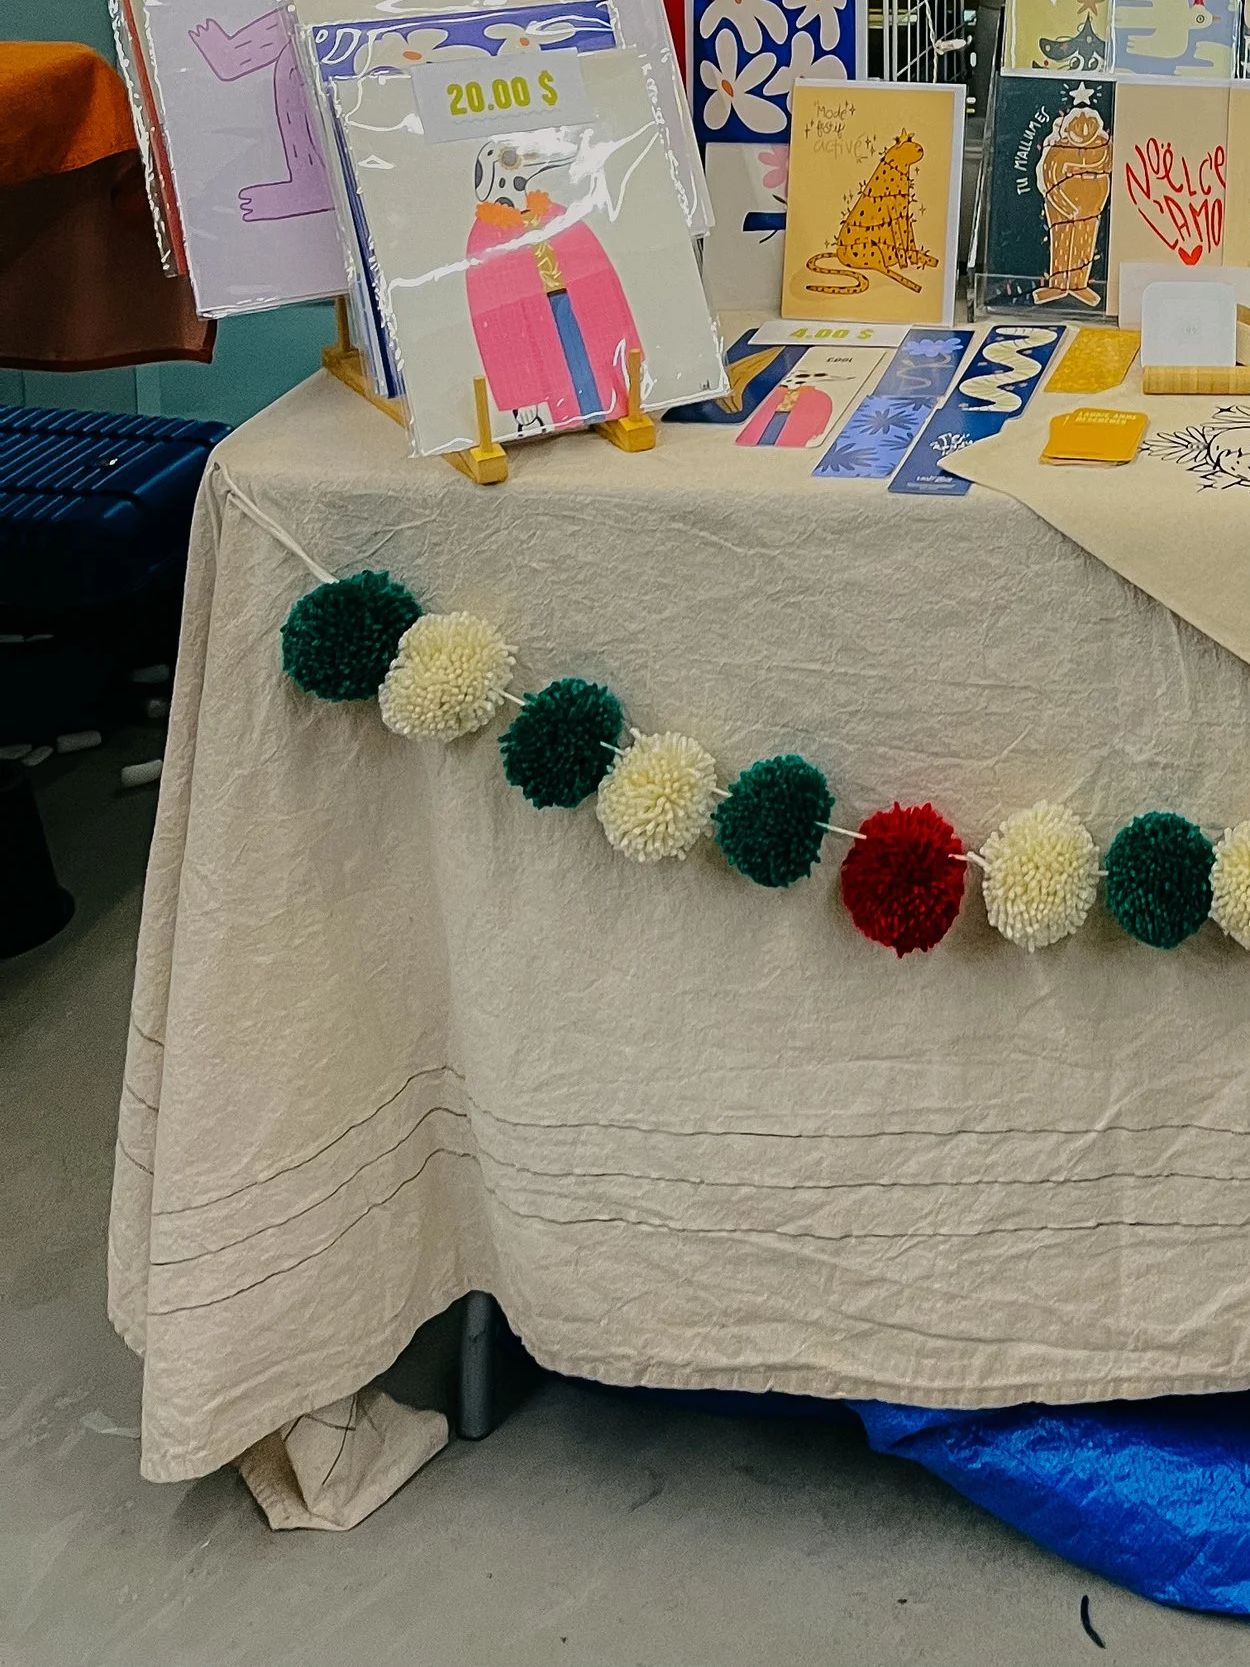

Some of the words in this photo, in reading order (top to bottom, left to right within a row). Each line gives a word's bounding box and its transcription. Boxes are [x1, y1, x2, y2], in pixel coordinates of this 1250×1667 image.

[447, 76, 531, 116] 20.00
[538, 70, 559, 106] $
[1016, 176, 1032, 196] TU
